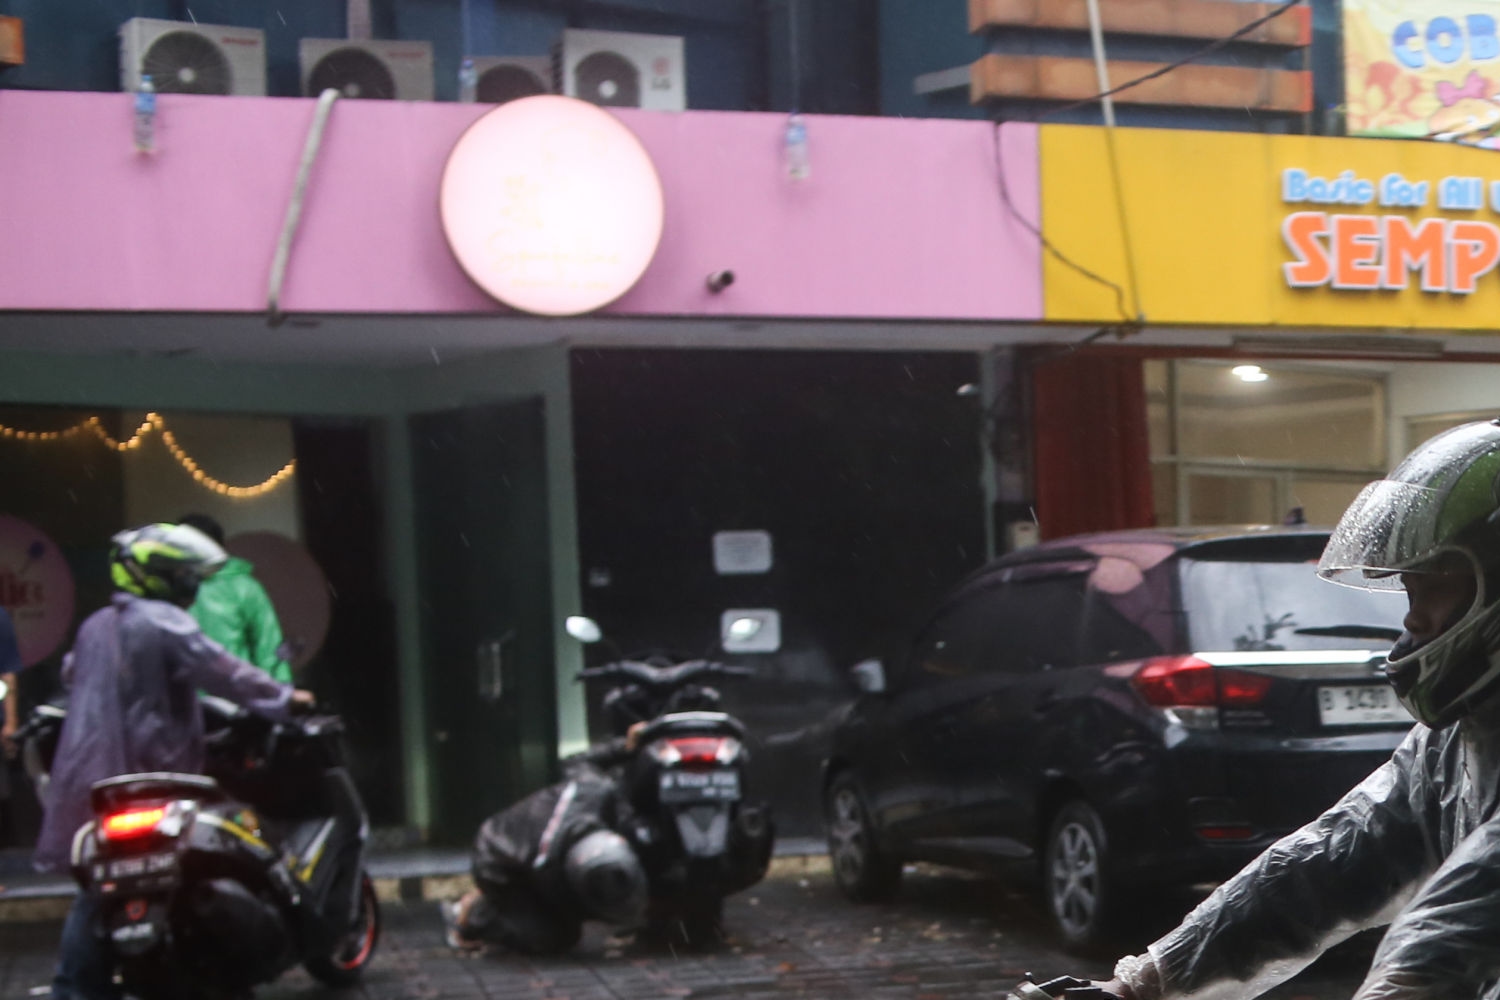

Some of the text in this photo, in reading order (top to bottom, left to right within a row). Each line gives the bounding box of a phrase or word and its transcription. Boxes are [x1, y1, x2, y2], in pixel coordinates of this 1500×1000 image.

[1285, 168, 1374, 204] Basic
[1380, 172, 1428, 208] for
[1438, 177, 1484, 210] All
